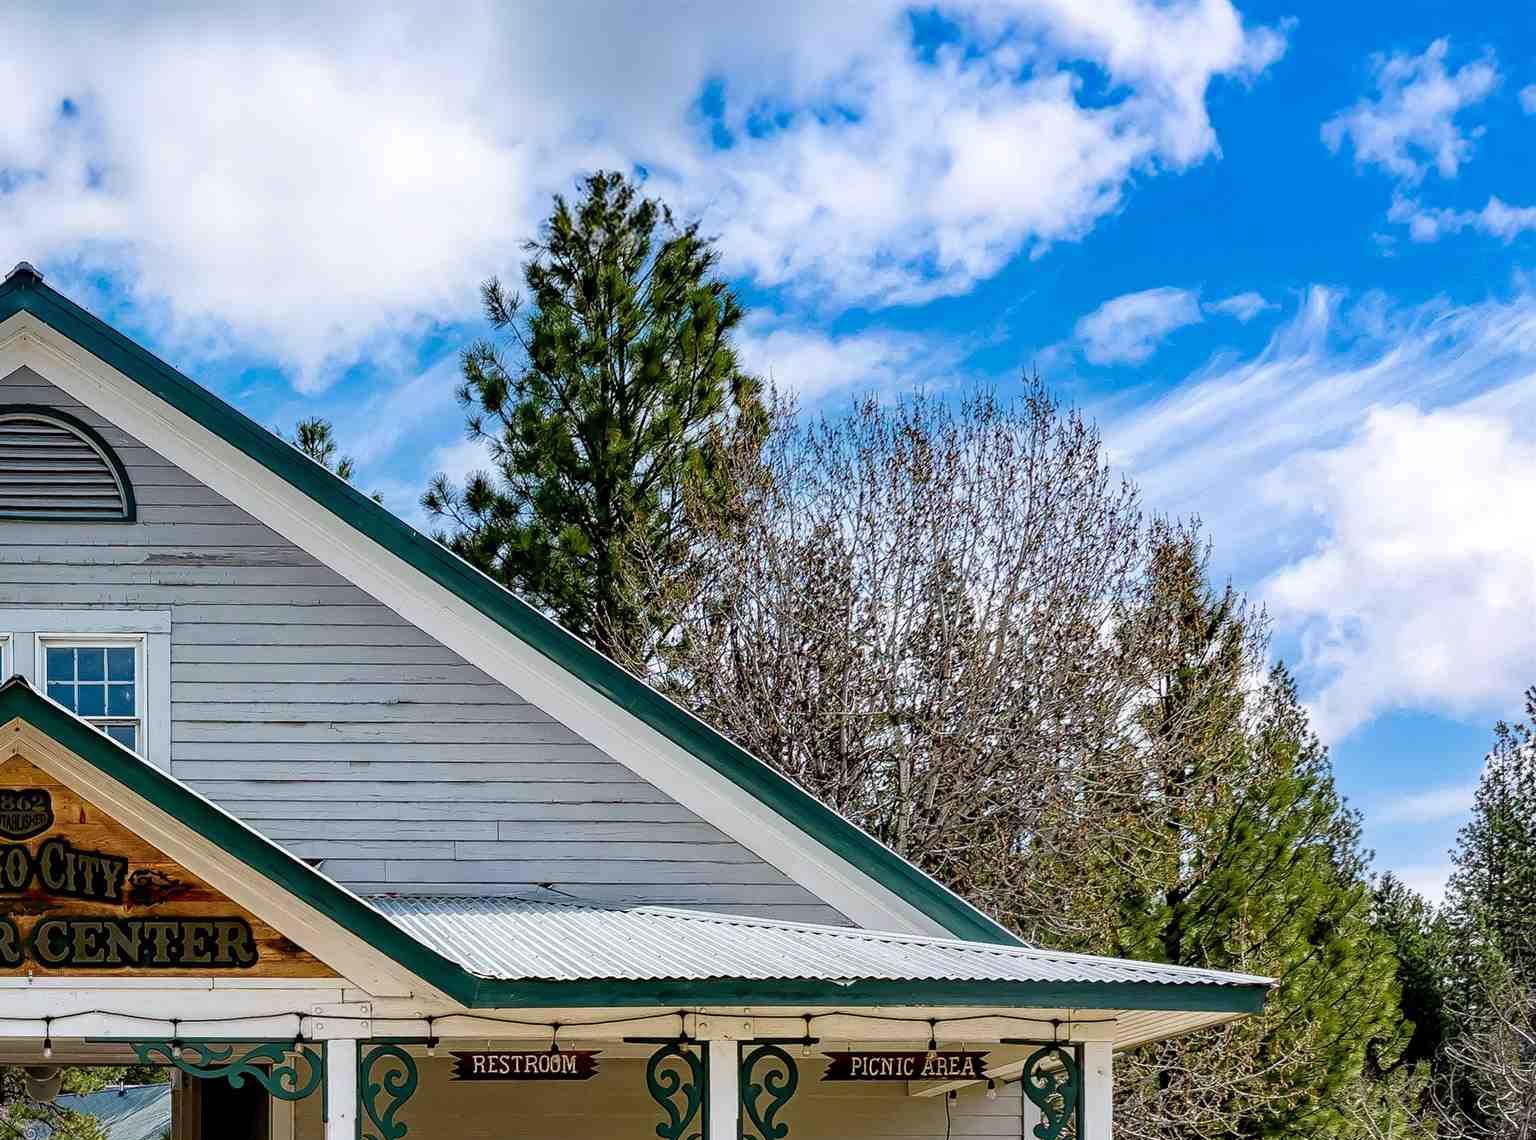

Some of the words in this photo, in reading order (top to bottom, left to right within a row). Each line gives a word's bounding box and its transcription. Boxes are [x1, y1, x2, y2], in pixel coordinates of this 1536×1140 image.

[40, 842, 124, 898] CITY
[33, 921, 250, 964] CENTER
[472, 1054, 577, 1074] RESTROOM
[850, 1056, 914, 1076] PICNIC
[920, 1056, 976, 1076] AREA
